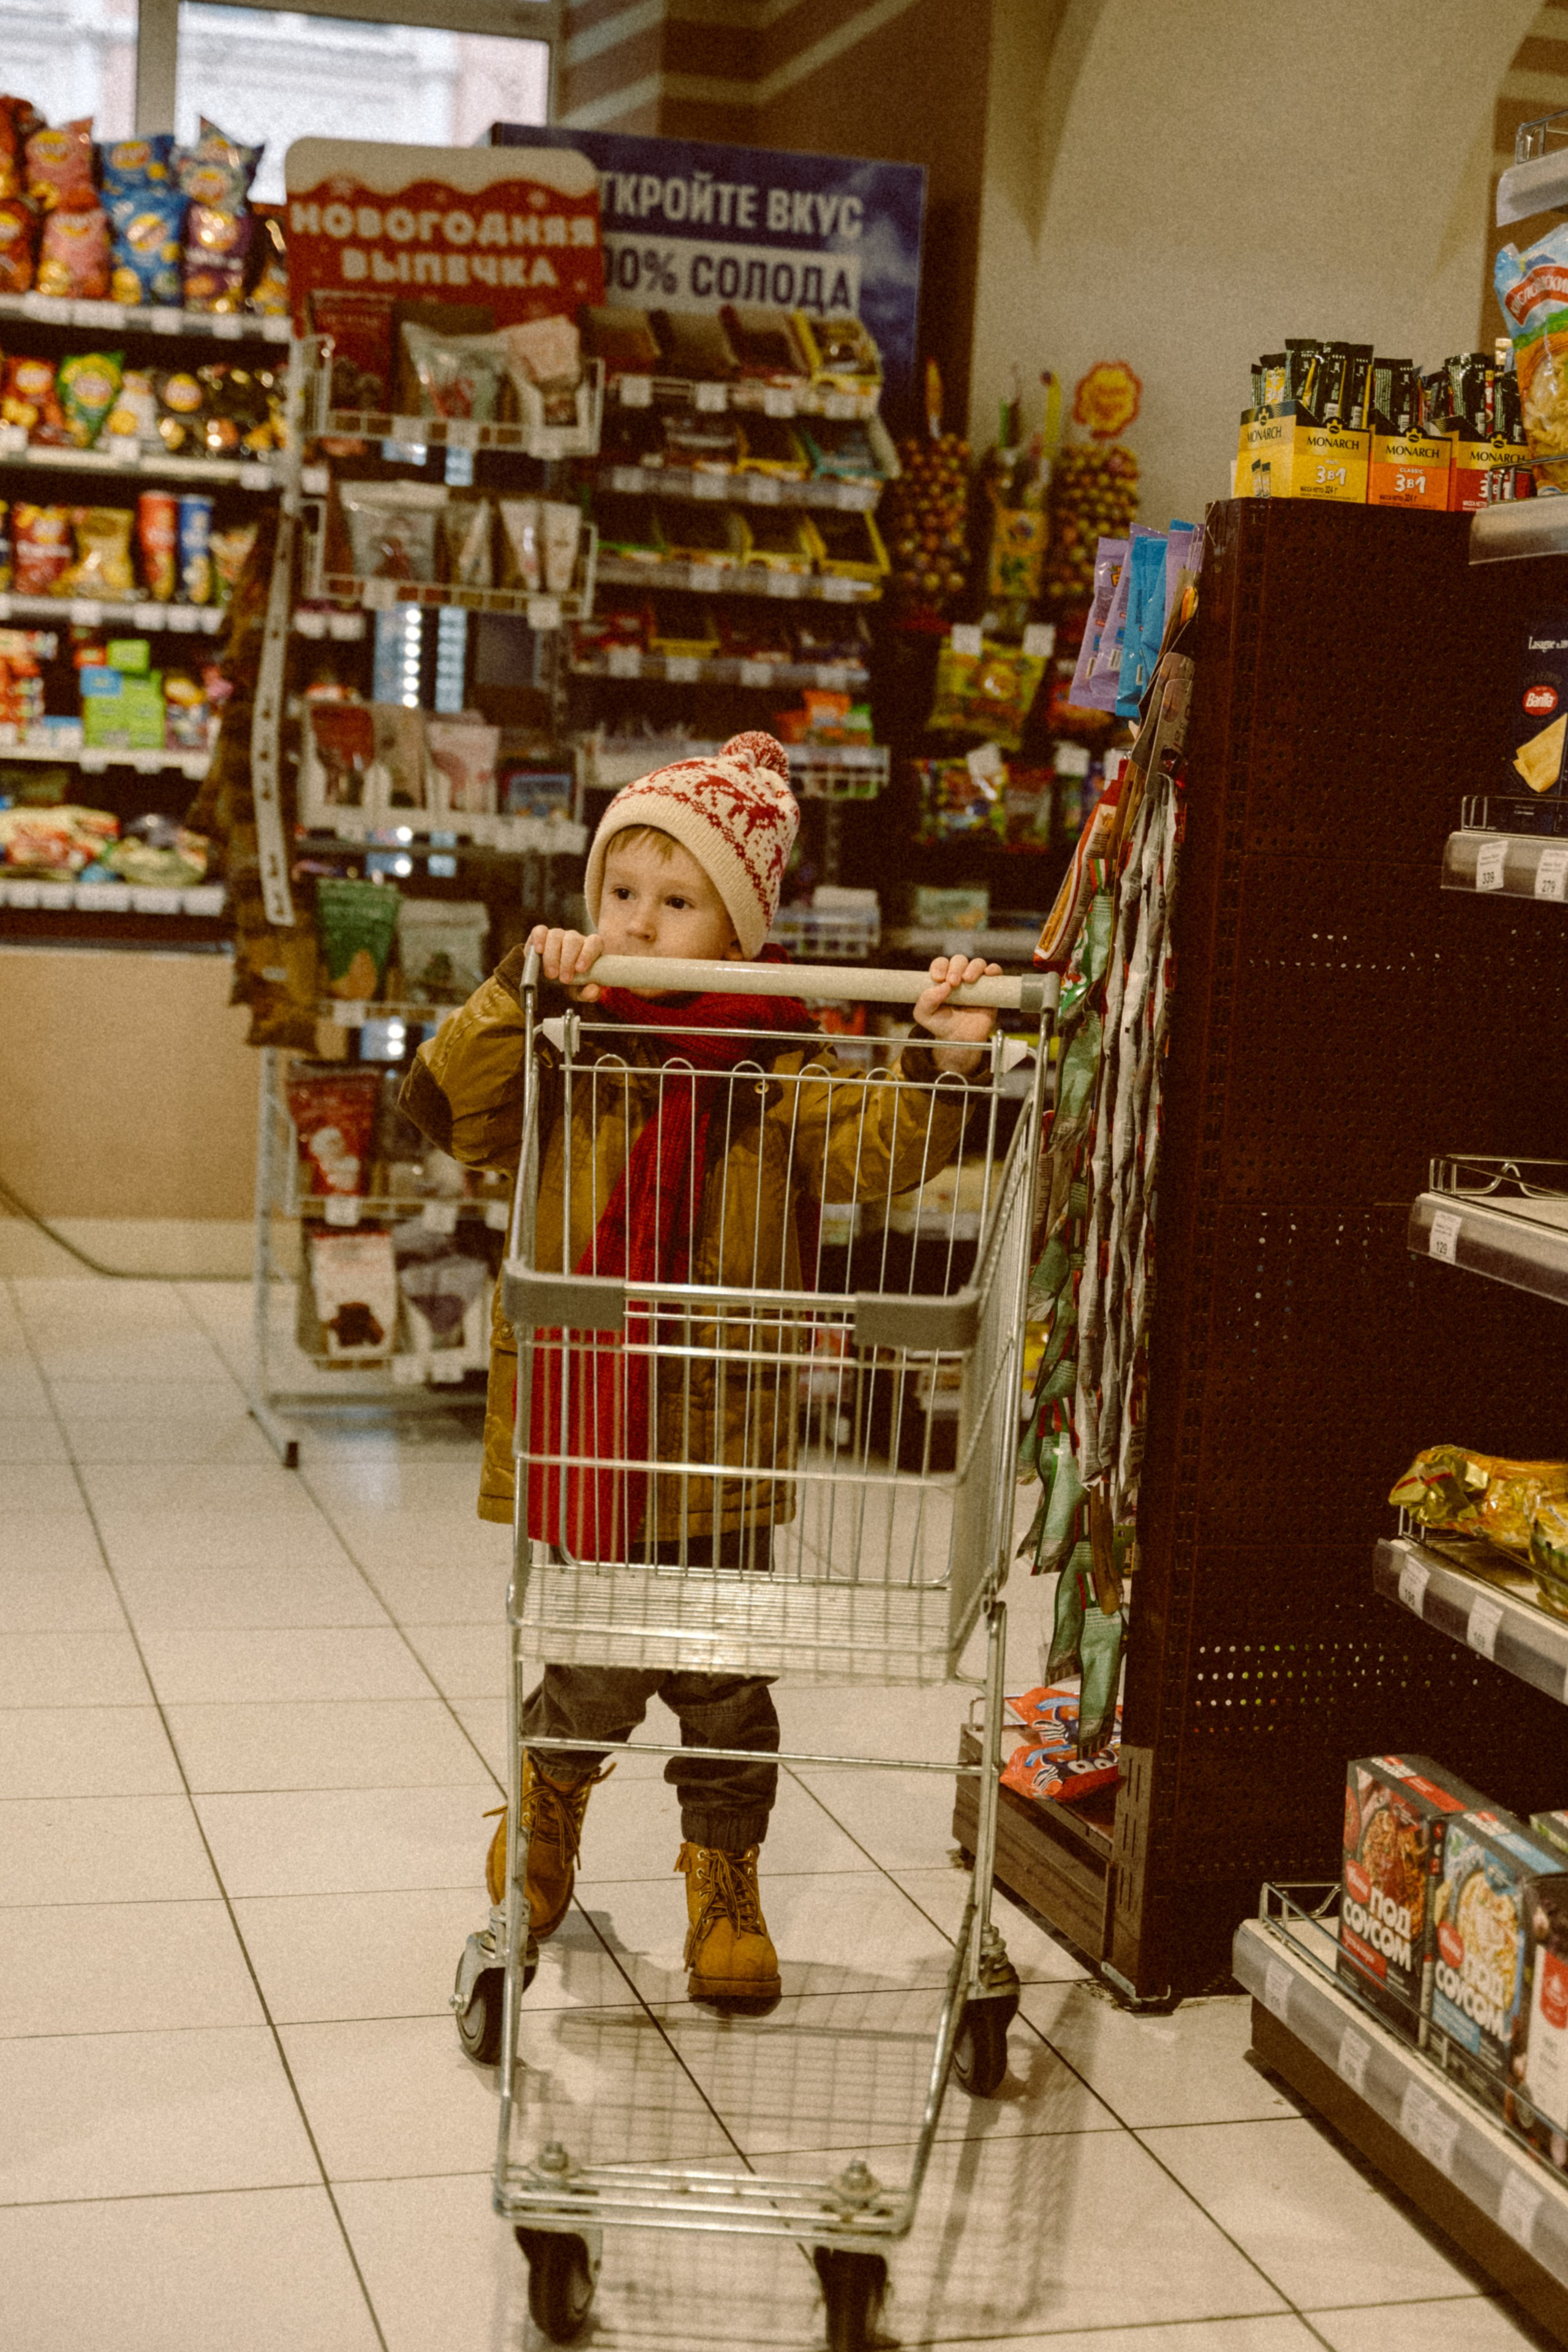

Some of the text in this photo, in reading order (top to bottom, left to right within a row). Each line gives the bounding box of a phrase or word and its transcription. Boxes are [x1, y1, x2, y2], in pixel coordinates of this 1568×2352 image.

[767, 187, 864, 239] ВКУС
[290, 201, 597, 246] НОВОГОДНЯЯ
[341, 247, 560, 288] ВЫПЕЧКА
[605, 247, 851, 316] 0% СОЛОДА
[1247, 426, 1283, 443] MONARCH
[1306, 436, 1360, 450] MONARCH
[1385, 445, 1440, 459] MONARCH
[1470, 451, 1526, 463] MONARCH
[1525, 692, 1555, 707] Barilla
[1482, 871, 1495, 884] 339
[1542, 880, 1556, 893] 279
[1436, 1241, 1448, 1255] 129
[1369, 1885, 1412, 1940] ПОД
[1343, 1896, 1412, 1972] СОУСОМ
[1434, 1959, 1506, 2041] СОУСОМ
